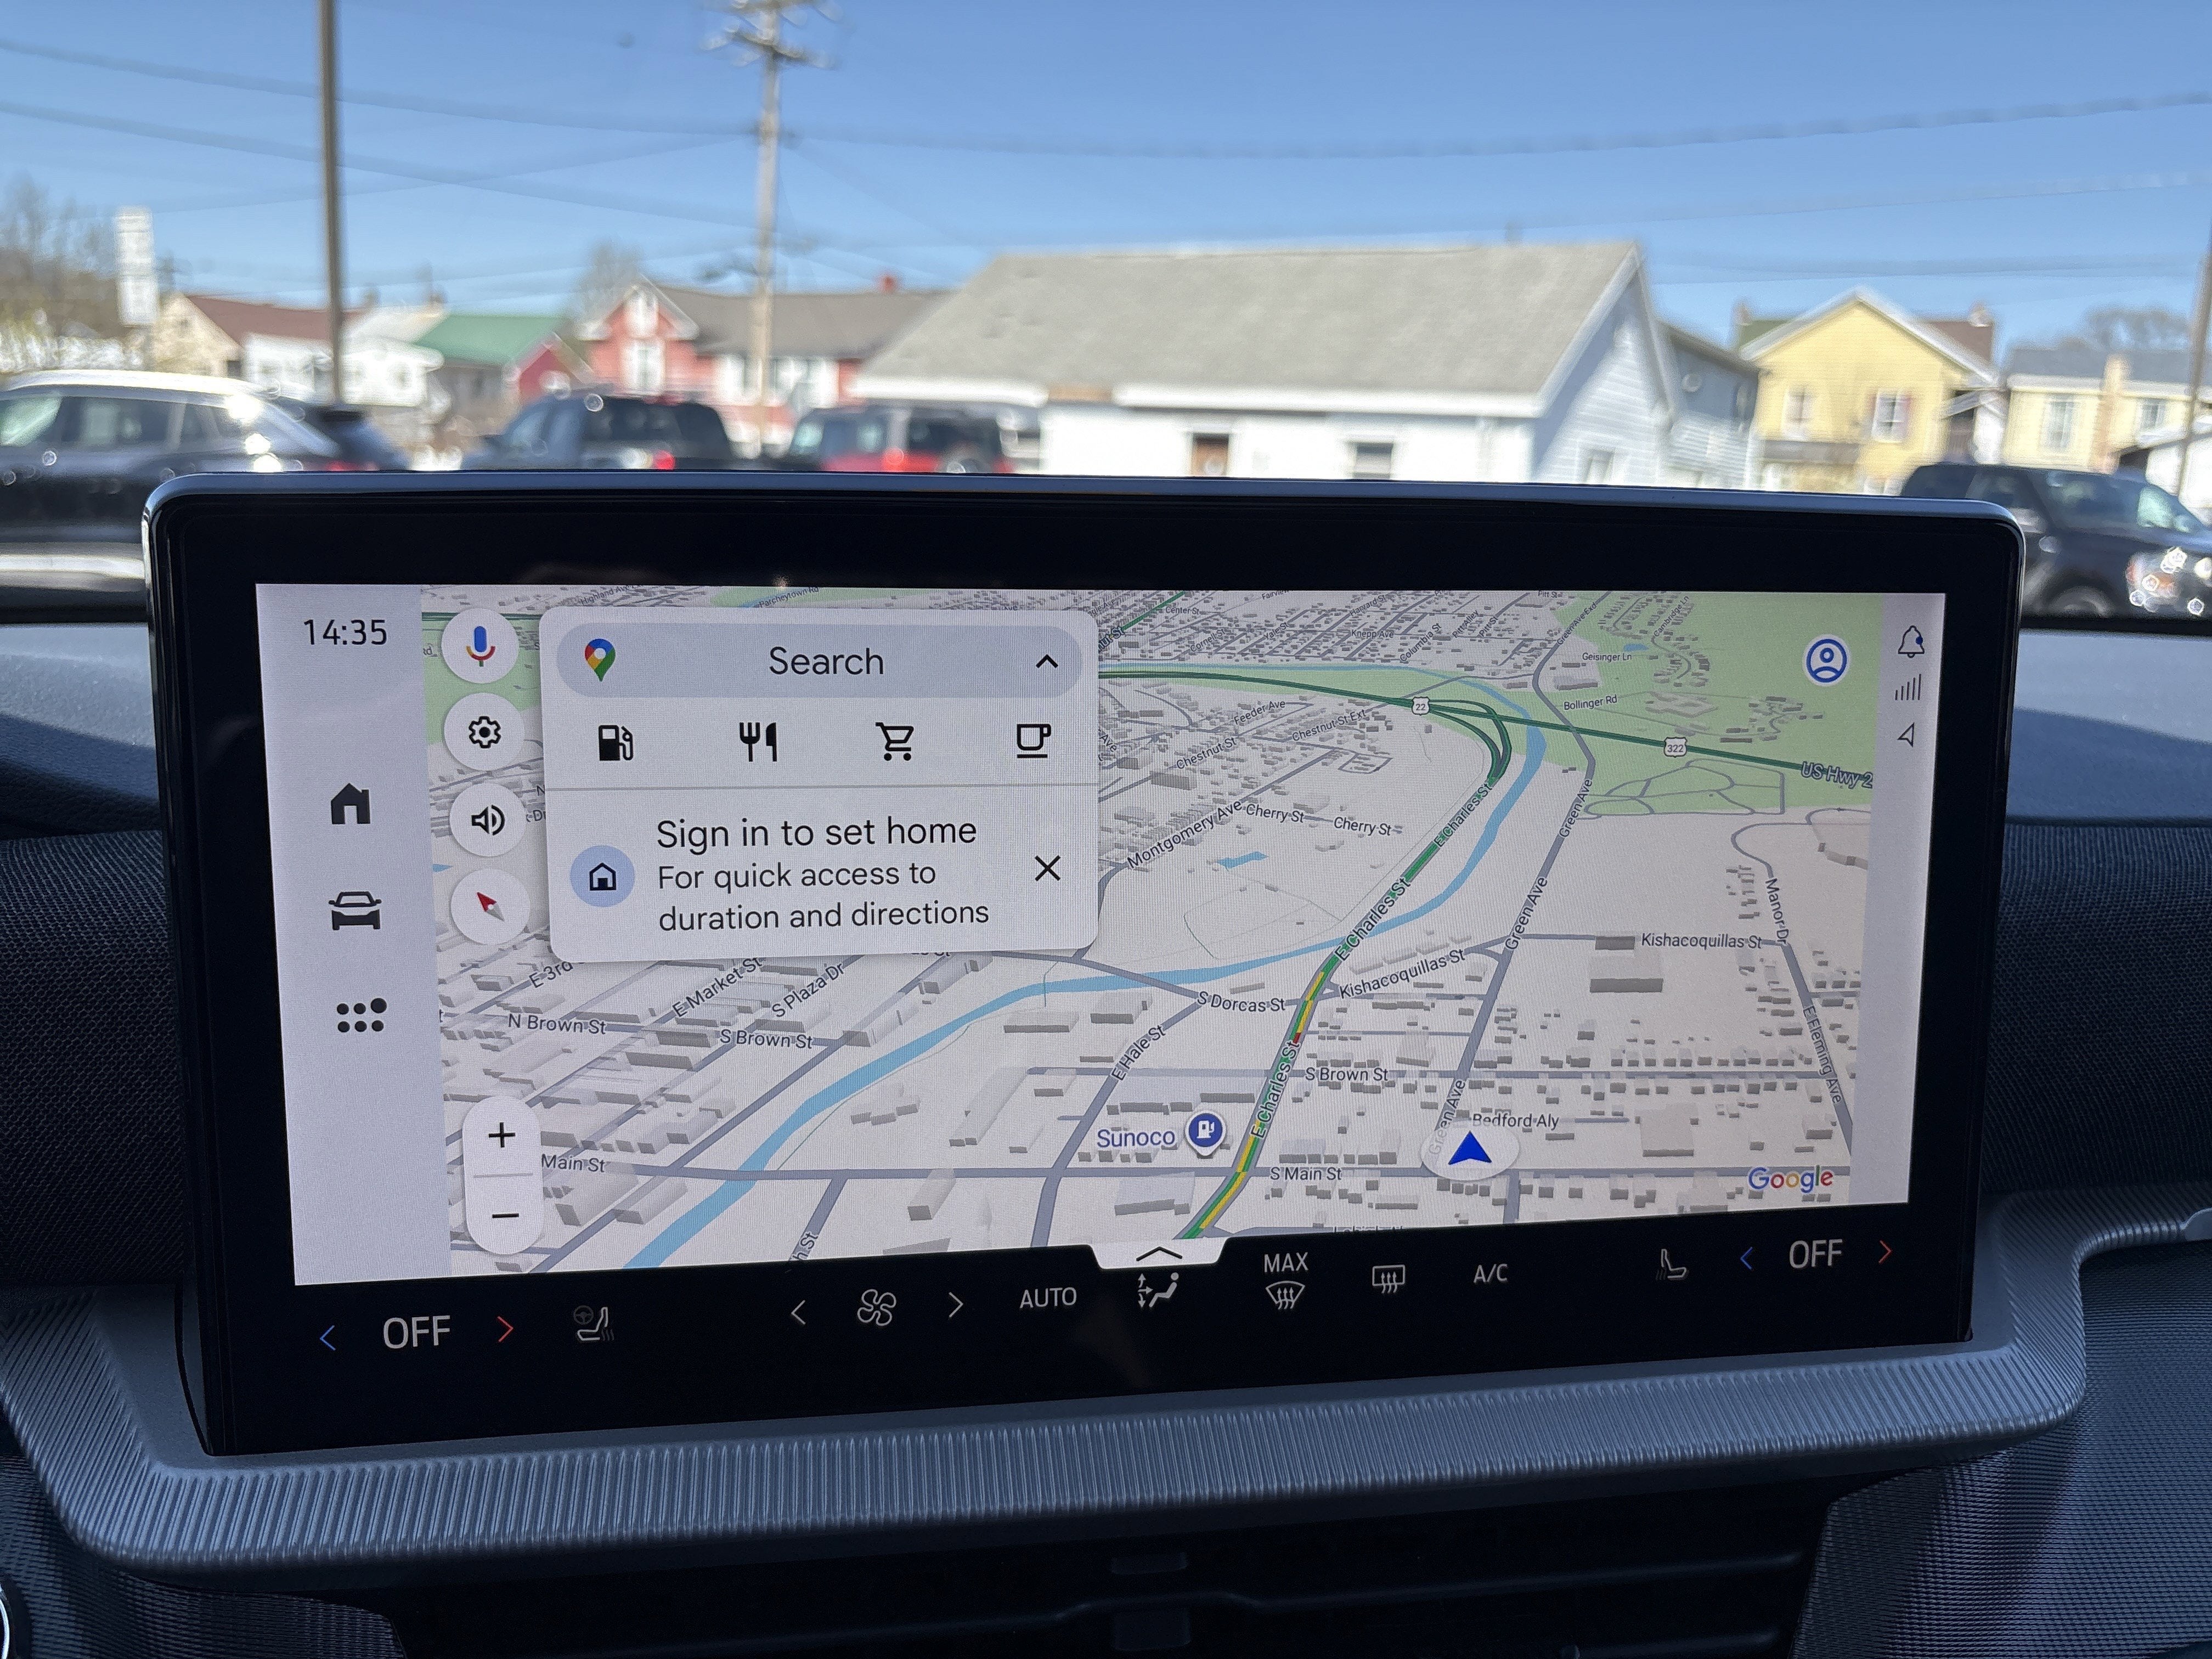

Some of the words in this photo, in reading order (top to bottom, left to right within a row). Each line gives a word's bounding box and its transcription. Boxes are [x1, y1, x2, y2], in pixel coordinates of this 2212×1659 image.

[1350, 598, 1378, 616] Harvard
[1378, 594, 1386, 602] St
[1654, 605, 1682, 636] Cambridge
[1679, 596, 1689, 605] Ln
[302, 618, 387, 646] 14:35
[1111, 626, 1125, 639] St
[1265, 627, 1280, 640] Yale
[1280, 622, 1289, 630] St
[1351, 627, 1376, 638] Knepp
[1452, 625, 1465, 638] Pitt
[1463, 610, 1480, 628] Alley
[1479, 625, 1492, 637] Pitt
[1489, 616, 1498, 627] St
[1557, 625, 1575, 646] Green
[1573, 614, 1585, 627] Ave
[1190, 634, 1216, 652] Cornell
[1216, 628, 1225, 637] St
[1400, 631, 1434, 662] Columbia
[1432, 623, 1442, 633] St
[769, 647, 884, 675] Search
[1582, 652, 1620, 663] Geisinger
[1234, 704, 1266, 725] Feeder
[1268, 701, 1285, 712] Ave
[1564, 698, 1603, 710] Bollinger
[1605, 694, 1618, 704] Rd
[1292, 719, 1336, 741] Chestnut
[1337, 714, 1349, 725] St
[1350, 709, 1367, 721] Ext
[1176, 743, 1223, 769] Chestnut
[1224, 737, 1237, 748] St
[1667, 744, 1684, 753] 322
[1801, 761, 1824, 780] US
[1826, 765, 1859, 789] Hwy
[1246, 804, 1288, 823] Cherry
[1290, 810, 1304, 823] St
[1434, 835, 1445, 848] E
[1442, 797, 1481, 837] Charles
[1477, 783, 1492, 798] St
[1559, 803, 1583, 838] Green
[1577, 778, 1593, 803] Ave
[658, 818, 729, 855] Sign
[742, 817, 769, 846] in
[782, 821, 814, 845] to
[826, 820, 874, 845] set
[887, 816, 977, 844] home
[1127, 815, 1214, 869] Montgomery
[1216, 800, 1243, 821] Ave
[1334, 817, 1375, 837] Cherry
[1378, 823, 1392, 836] St
[659, 865, 704, 889] For
[714, 862, 791, 894] quick
[801, 866, 899, 886] access
[910, 862, 935, 884] to
[659, 904, 778, 930] duration
[790, 902, 841, 928] and
[852, 900, 989, 927] directions
[1335, 946, 1350, 962] E
[1346, 896, 1395, 948] Charles
[1391, 878, 1411, 896] St
[1505, 906, 1533, 950] Green
[1527, 877, 1548, 905] Ave
[1765, 879, 1785, 927] Manor
[1776, 928, 1789, 945] Dr
[1641, 933, 1745, 949] Kishacoquillas
[1747, 935, 1762, 949] St
[529, 972, 544, 988] E
[1339, 956, 1447, 998] Kishacoquillas
[1449, 949, 1465, 965] St
[673, 1002, 685, 1018] E
[684, 968, 743, 1008] Market
[742, 957, 762, 973] St
[771, 1003, 786, 1018] S
[784, 974, 827, 1009] Plaza
[826, 961, 845, 981] Dr
[1197, 991, 1209, 1005] S
[1211, 993, 1266, 1012] Dorcas
[1271, 997, 1285, 1012] St
[1803, 1006, 1815, 1017] E
[507, 1014, 521, 1028] N
[527, 1015, 585, 1034] Brown
[588, 1020, 606, 1035] St
[720, 1029, 731, 1044] S
[736, 1030, 791, 1048] Brown
[795, 1034, 812, 1049] St
[1283, 1040, 1300, 1060] St
[1807, 1019, 1832, 1076] Fleming
[1111, 1063, 1126, 1081] E
[1120, 1039, 1150, 1070] Hale
[1148, 1024, 1166, 1042] St
[1305, 1068, 1316, 1081] S
[1319, 1068, 1368, 1081] Brown
[1373, 1068, 1388, 1081] St
[1257, 1063, 1291, 1124] Charles
[1447, 1080, 1466, 1109] Ave
[1826, 1077, 1841, 1103] Ave
[1251, 1125, 1266, 1138] E
[1537, 1114, 1559, 1131] Aly
[1097, 1130, 1176, 1148] Sunoco
[541, 1153, 582, 1171] Main
[588, 1158, 605, 1172] St
[1269, 1167, 1280, 1180] S
[1284, 1167, 1322, 1180] Main
[1327, 1167, 1342, 1181] St
[1748, 1165, 1833, 1193] Google
[800, 1232, 818, 1249] St
[1263, 1251, 1308, 1276] MAX
[1788, 1239, 1843, 1270] OFF
[1473, 1262, 1509, 1285] A/C
[1019, 1286, 1077, 1310] AUTO
[382, 1314, 450, 1350] OFF
